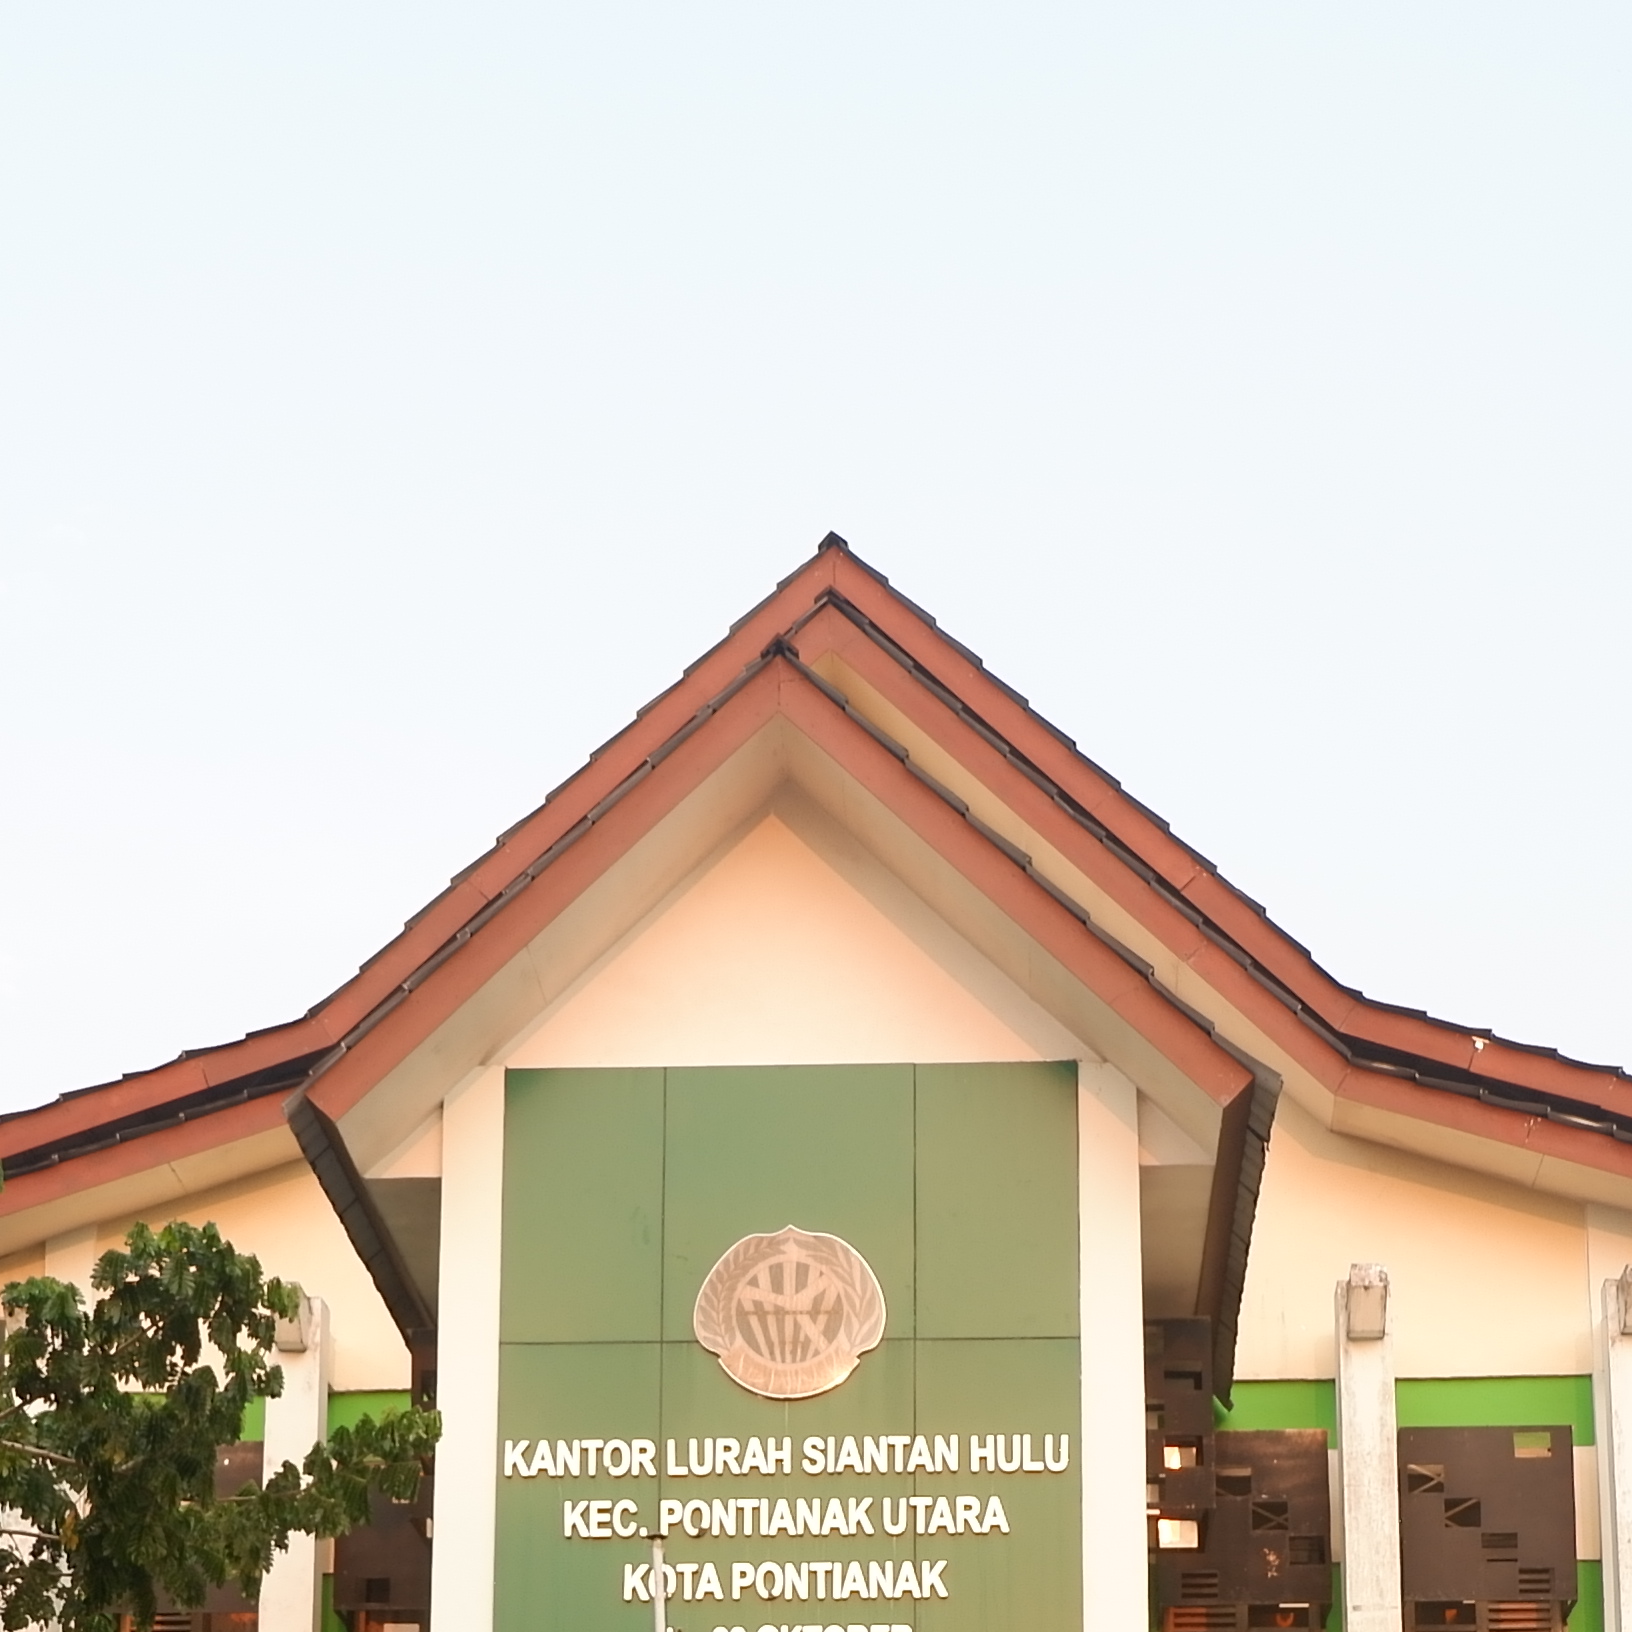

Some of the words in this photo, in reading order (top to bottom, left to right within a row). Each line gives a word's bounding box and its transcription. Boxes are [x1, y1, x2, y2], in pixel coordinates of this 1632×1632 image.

[504, 1438, 656, 1478] KANTOR
[667, 1436, 793, 1476] LURAH
[801, 1434, 960, 1475] SIANTAN
[970, 1433, 1070, 1474] HULU
[563, 1500, 648, 1539] KEC.
[660, 1497, 877, 1538] PONTIANAK
[882, 1495, 1011, 1535] UTARA
[623, 1562, 724, 1602] KOTA
[731, 1560, 949, 1600] PONTIANAK
